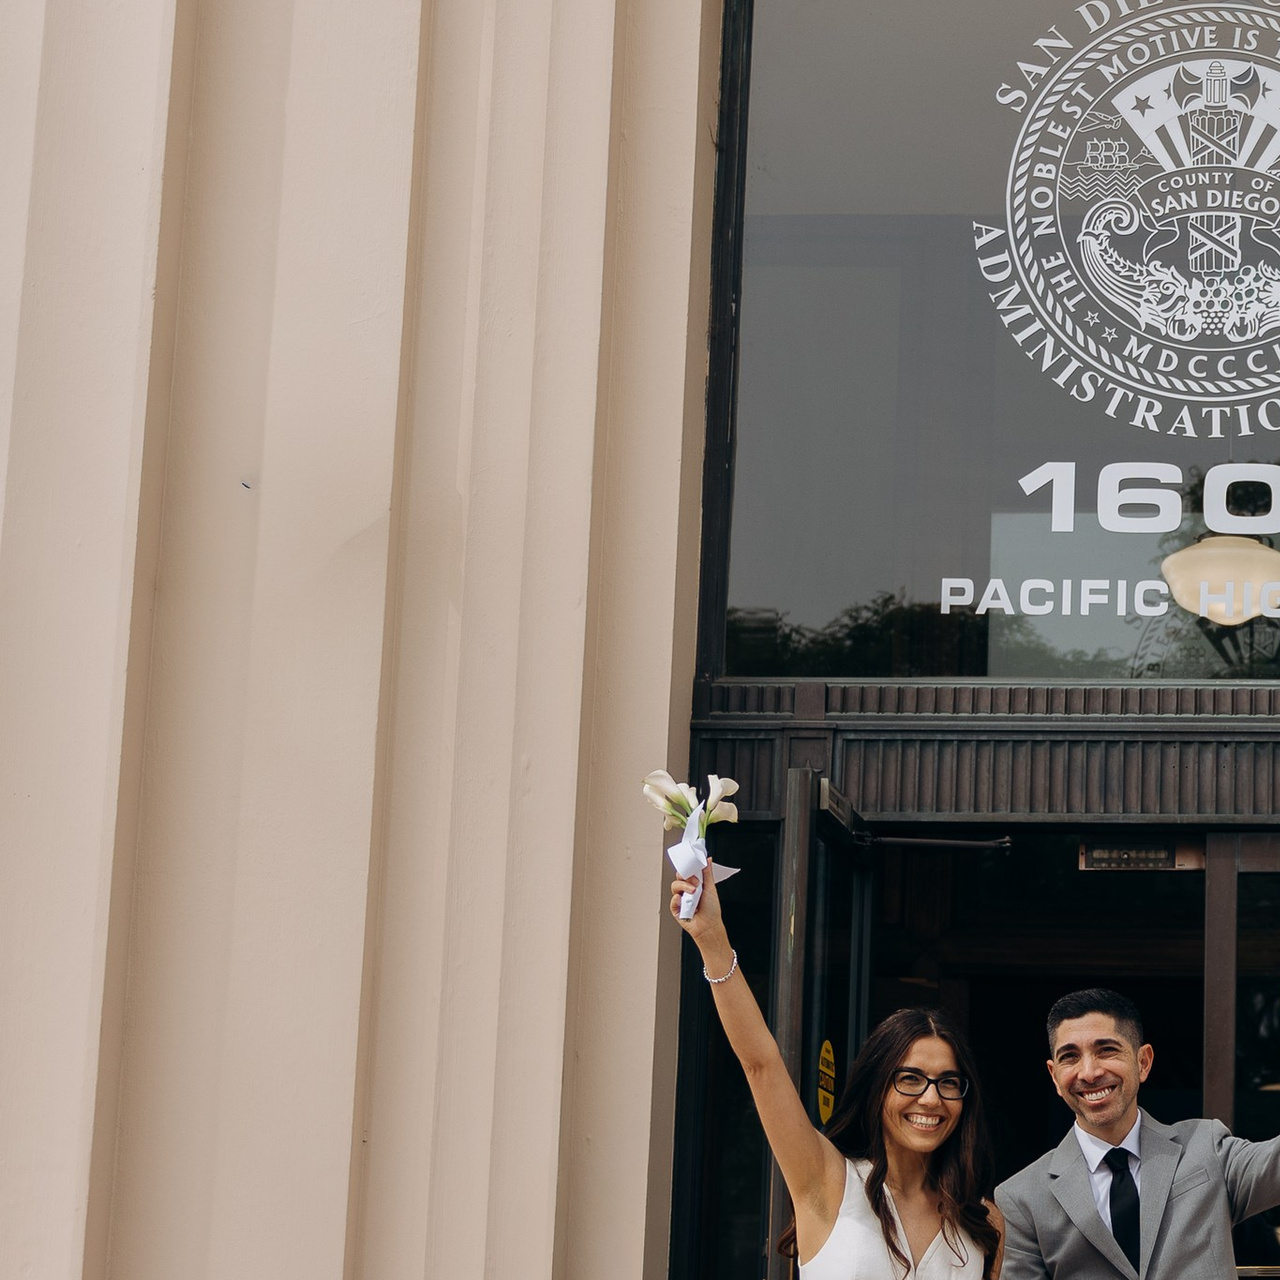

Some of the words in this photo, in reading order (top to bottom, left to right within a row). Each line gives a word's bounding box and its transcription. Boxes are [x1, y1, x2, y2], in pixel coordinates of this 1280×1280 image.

[1097, 26, 1219, 84] MOTIVE
[1233, 26, 1260, 51] IS
[995, 25, 1074, 113] SAN
[1031, 82, 1099, 238] NOBLEST
[1157, 172, 1234, 193] COUNTY
[1251, 177, 1275, 193] OF
[1151, 190, 1199, 217] SAN
[1206, 189, 1280, 216] DIEGO
[1041, 251, 1086, 313] THE
[940, 577, 1170, 617] PACIFIC
